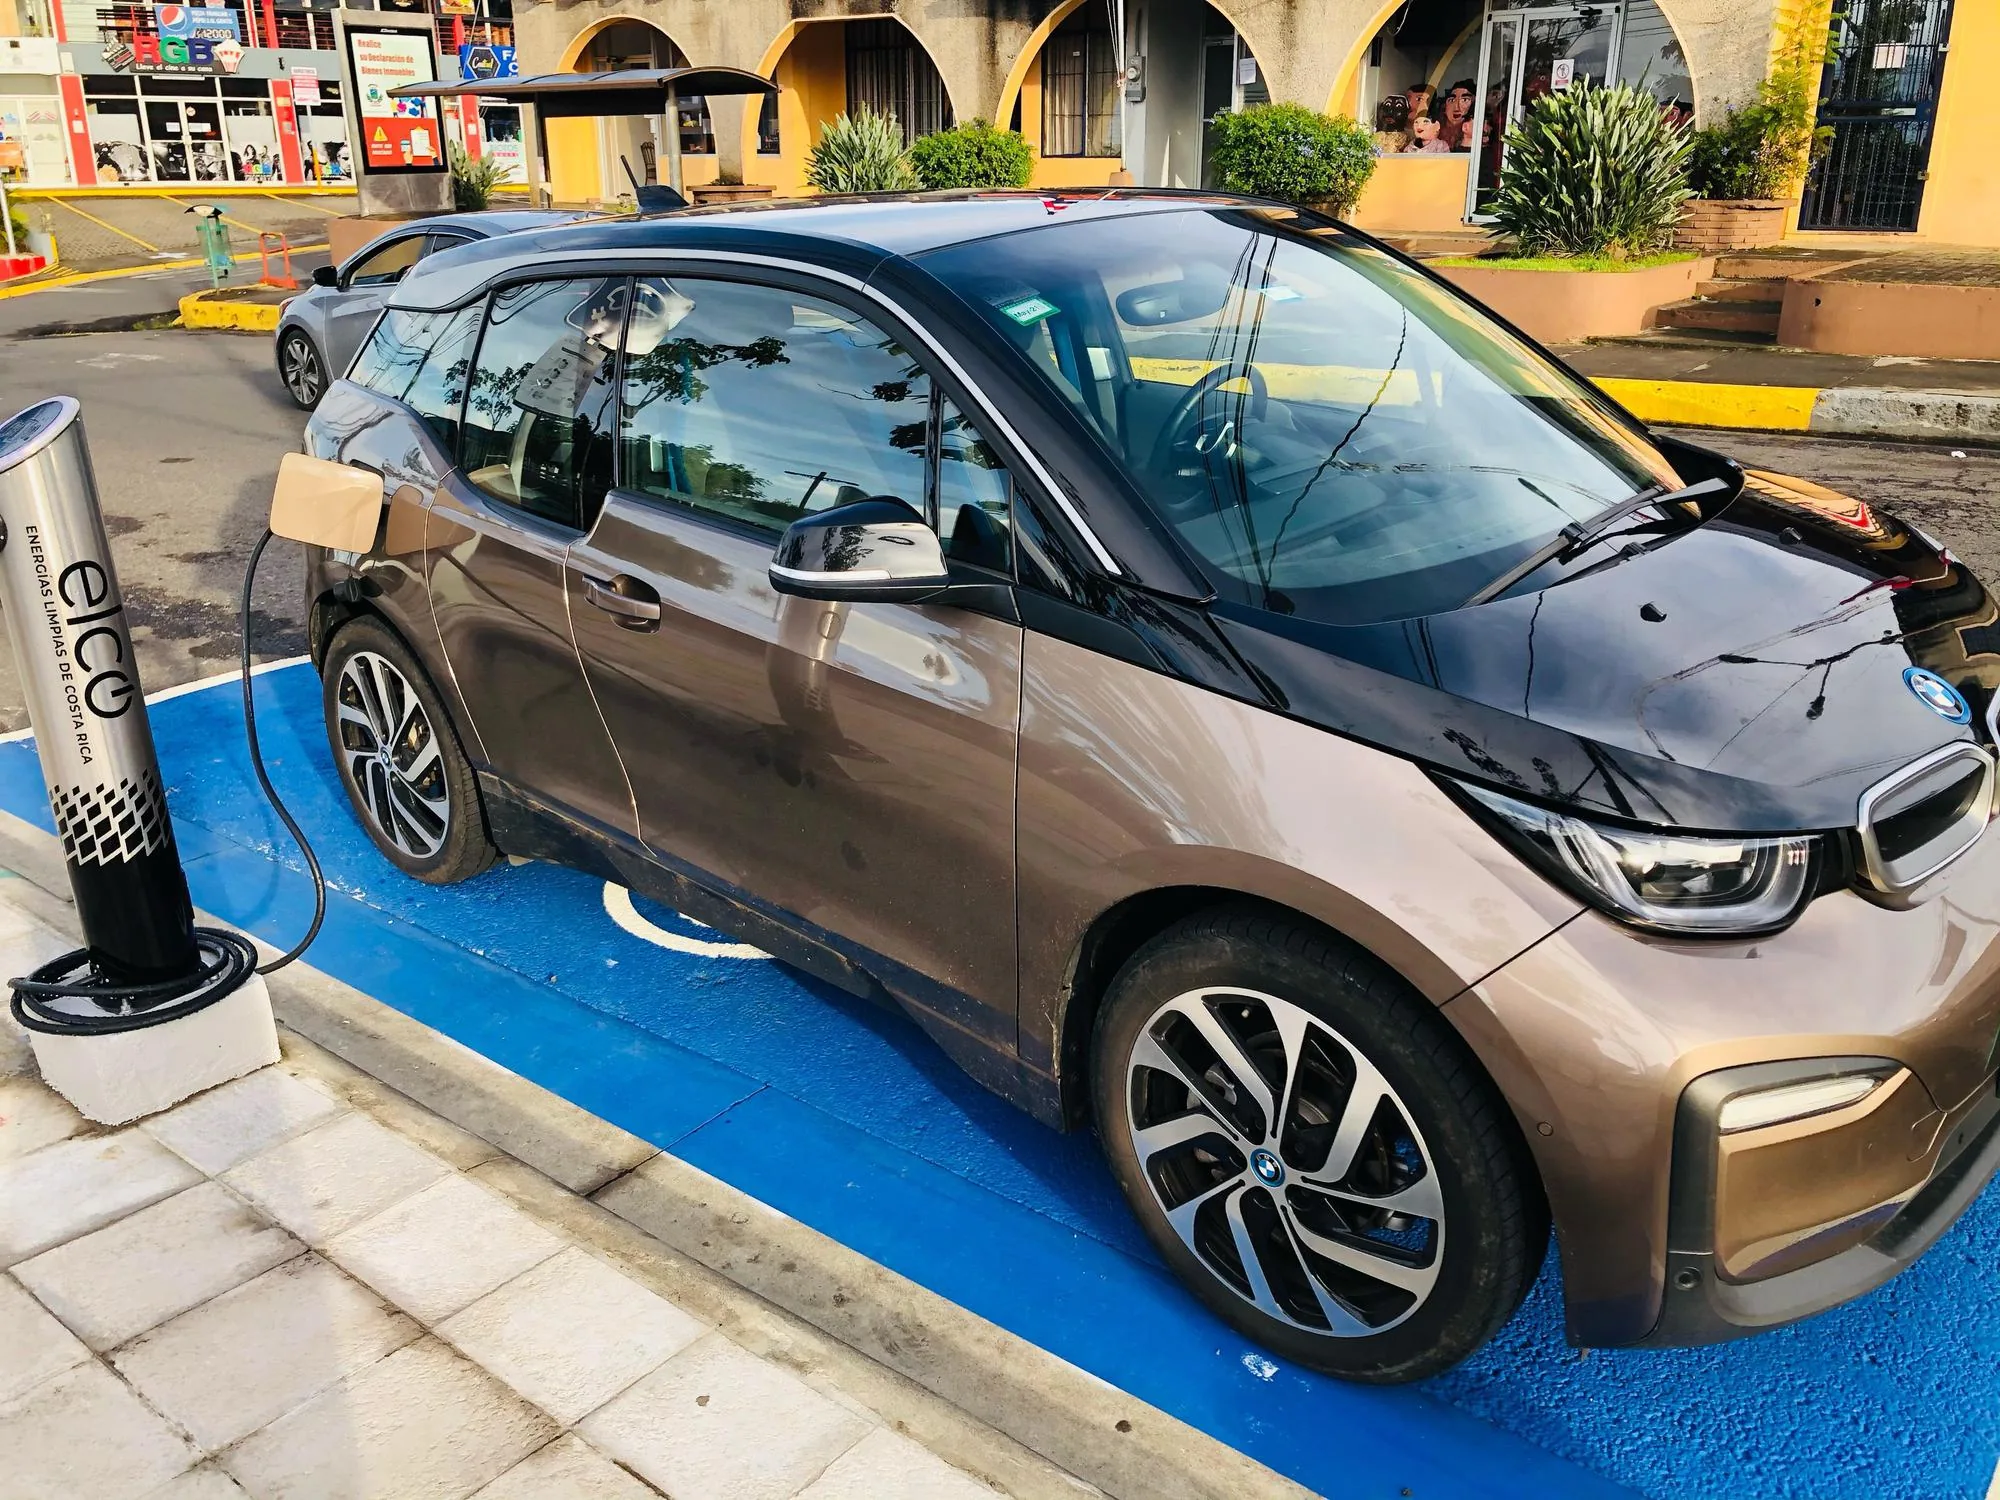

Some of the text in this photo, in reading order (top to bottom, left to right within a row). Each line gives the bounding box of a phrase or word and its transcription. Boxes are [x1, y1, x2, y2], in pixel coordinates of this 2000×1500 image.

[357, 39, 382, 49] Realice
[133, 35, 215, 65] RGB
[406, 54, 414, 63] de
[135, 63, 154, 71] Lleve
[164, 64, 179, 72] cine
[26, 525, 93, 765] ENERGÍAS LIMPIAS DE COSTA RICA
